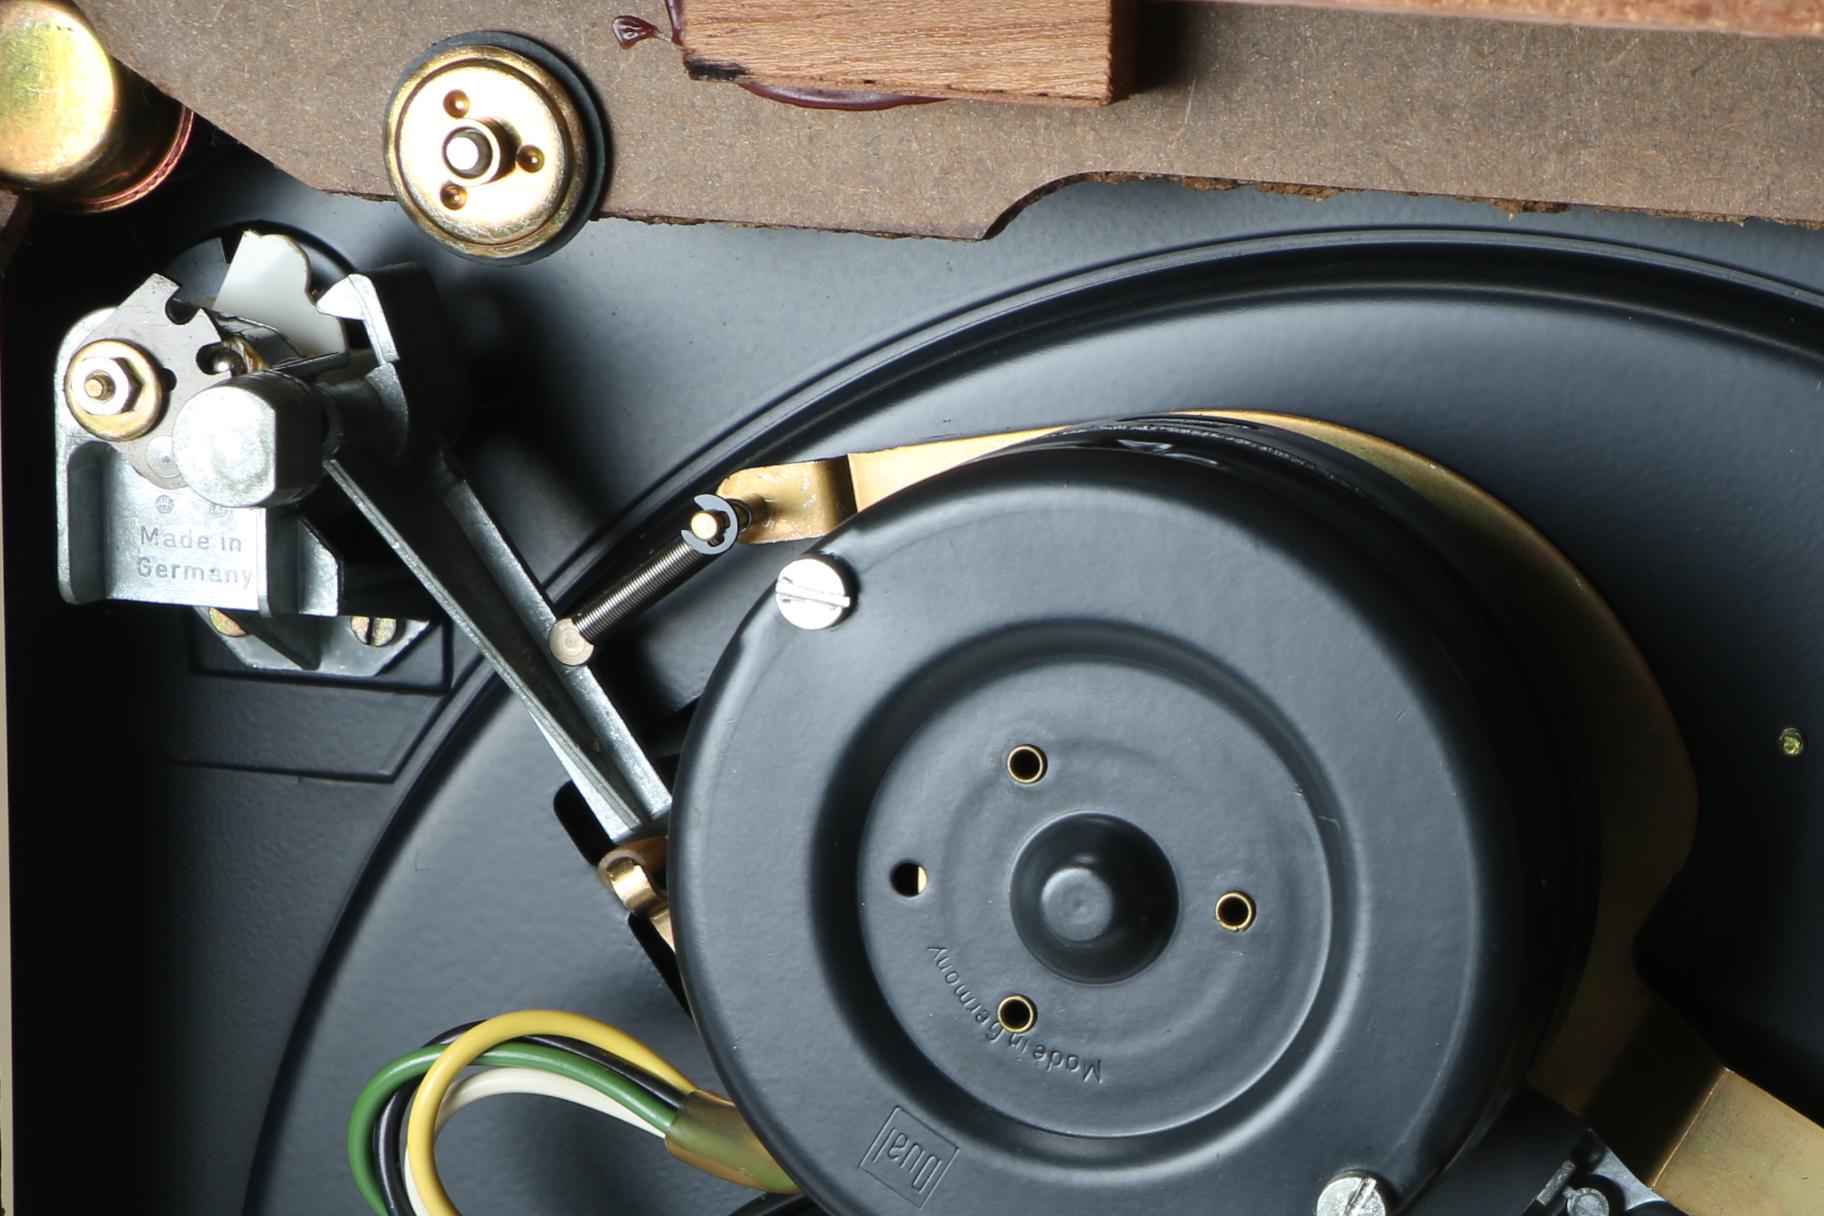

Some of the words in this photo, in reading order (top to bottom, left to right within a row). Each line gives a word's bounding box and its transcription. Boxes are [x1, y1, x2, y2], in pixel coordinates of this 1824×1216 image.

[139, 525, 210, 552] Made
[221, 530, 243, 553] in
[136, 555, 253, 590] Germany
[927, 945, 1005, 1044] Germany
[1032, 1043, 1103, 1084] Made
[871, 1126, 943, 1196] Dual
